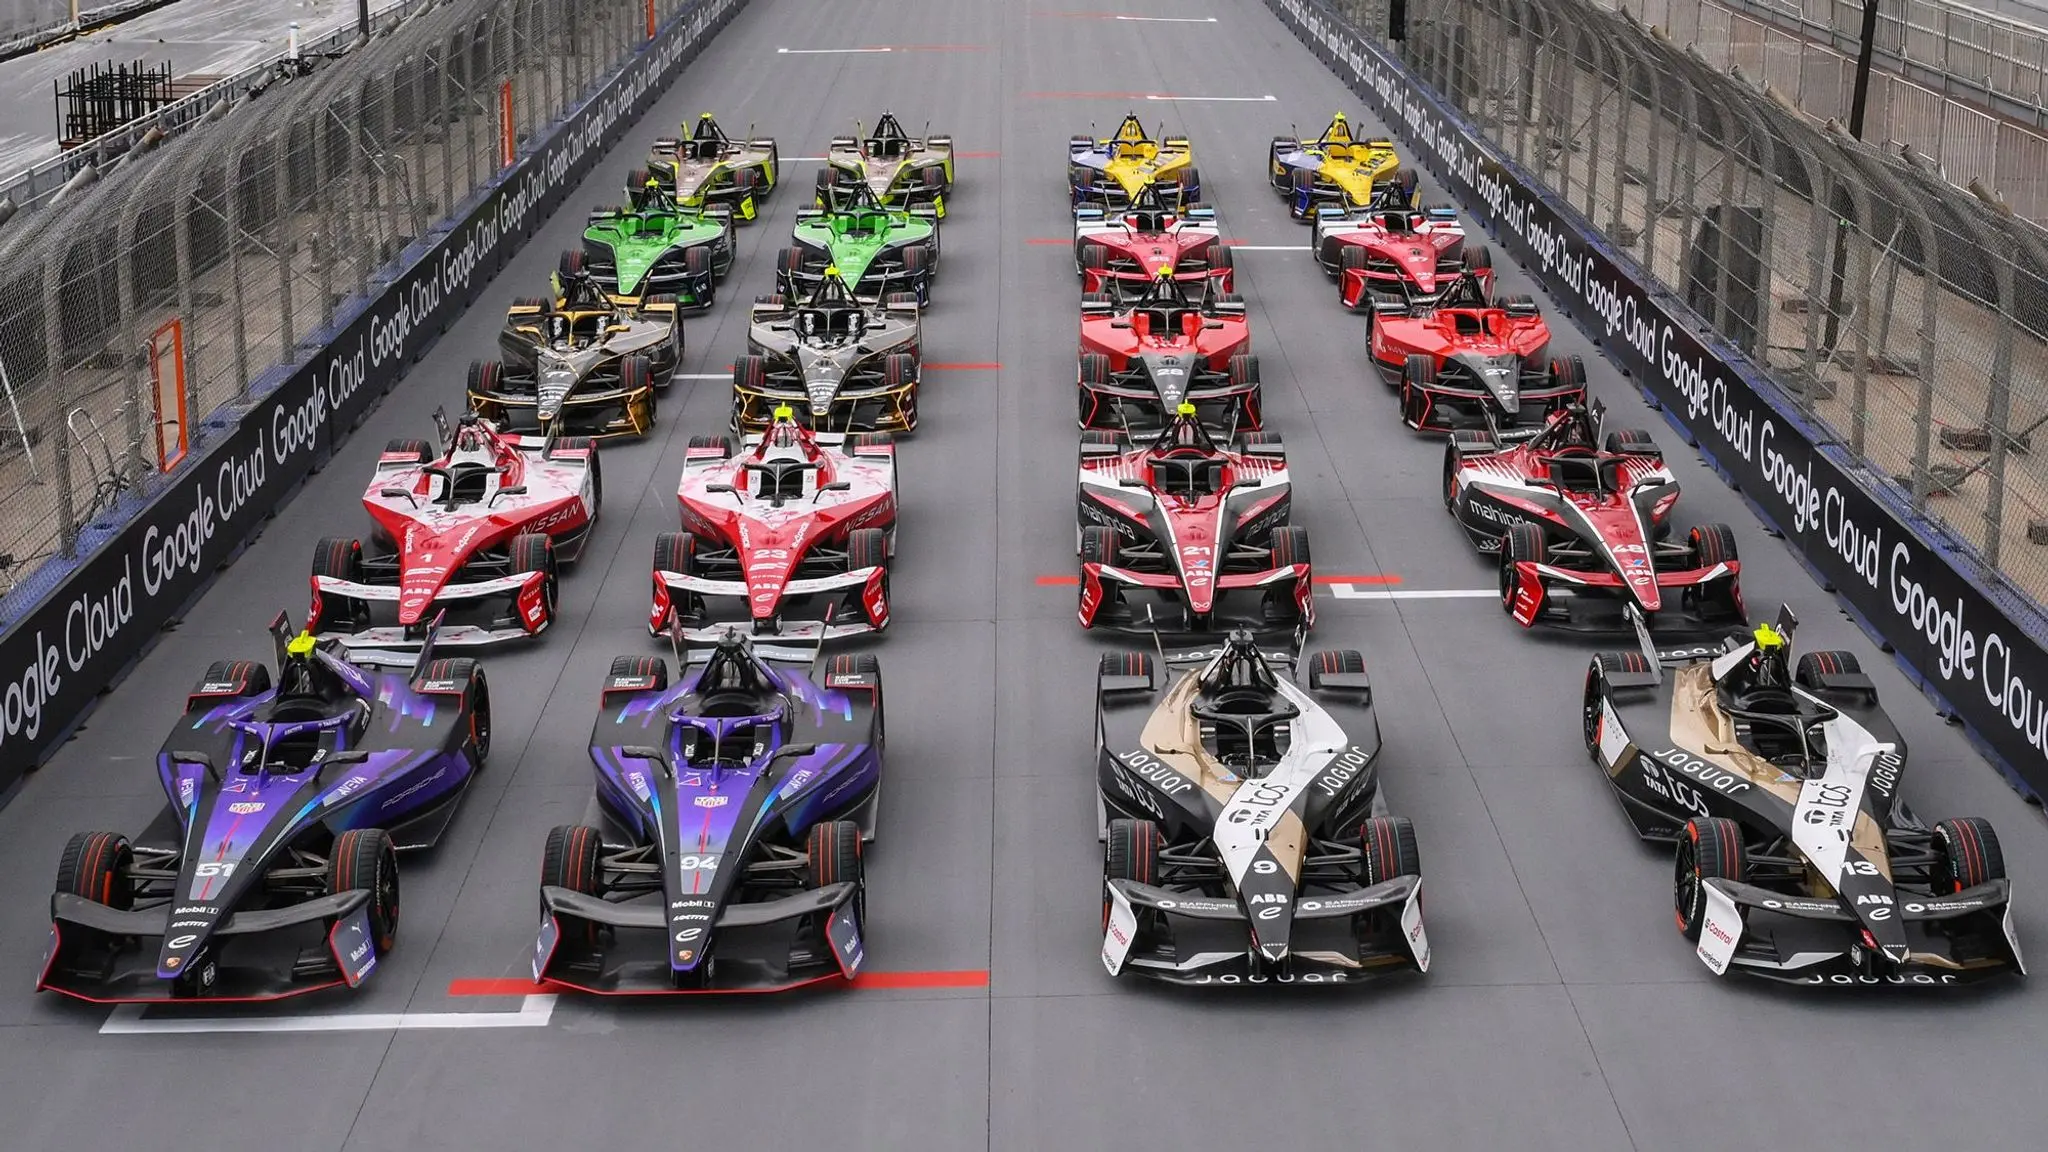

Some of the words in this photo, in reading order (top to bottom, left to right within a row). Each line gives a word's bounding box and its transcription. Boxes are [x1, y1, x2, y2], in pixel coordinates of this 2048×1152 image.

[585, 104, 603, 148] Google
[604, 91, 617, 129] Cloud
[1404, 88, 1420, 139] Google
[1421, 108, 1436, 149] Cloud
[547, 138, 568, 186] Google
[567, 123, 584, 166] Cloud
[1437, 119, 1457, 176] Google
[1457, 142, 1475, 188] Cloud
[501, 178, 526, 234] Google
[526, 159, 546, 207] Cloud
[1476, 156, 1502, 218] Google
[1503, 184, 1524, 236] Cloud
[443, 229, 475, 295] Google
[476, 206, 498, 260] Cloud
[1527, 203, 1554, 272] Google
[1556, 234, 1582, 293] Cloud
[370, 292, 410, 368] Google
[411, 263, 439, 326] Cloud
[1585, 257, 1622, 336] Google
[1624, 295, 1656, 364] Cloud
[272, 374, 326, 465] Google
[329, 334, 365, 410] Cloud
[1661, 325, 1709, 420] Google
[1712, 377, 1753, 462] Cloud
[143, 484, 215, 596] Google
[218, 428, 266, 521] Cloud
[520, 502, 580, 535] NISSAN
[1760, 420, 1820, 533] Google
[1824, 487, 1881, 588] Cloud
[421, 553, 433, 562] 1
[753, 549, 787, 559] 23
[1183, 546, 1210, 555] 21
[1613, 544, 1644, 553] 48
[0, 631, 61, 748] ogle
[66, 554, 132, 672] Cloud
[1890, 541, 1975, 680] Google
[1982, 633, 2048, 761] Clou
[338, 775, 368, 796] AVEVA
[381, 767, 447, 809] PORSCHE
[1643, 773, 1670, 798] TATA
[195, 862, 236, 877] 51
[681, 856, 718, 870] 94
[1253, 860, 1278, 875] 9
[1841, 861, 1880, 876] 13
[175, 906, 206, 914] Mobil
[672, 900, 703, 908] Mobil
[1250, 893, 1288, 905] ABB
[1856, 894, 1894, 905] ABB
[1709, 922, 1733, 946] Castrol
